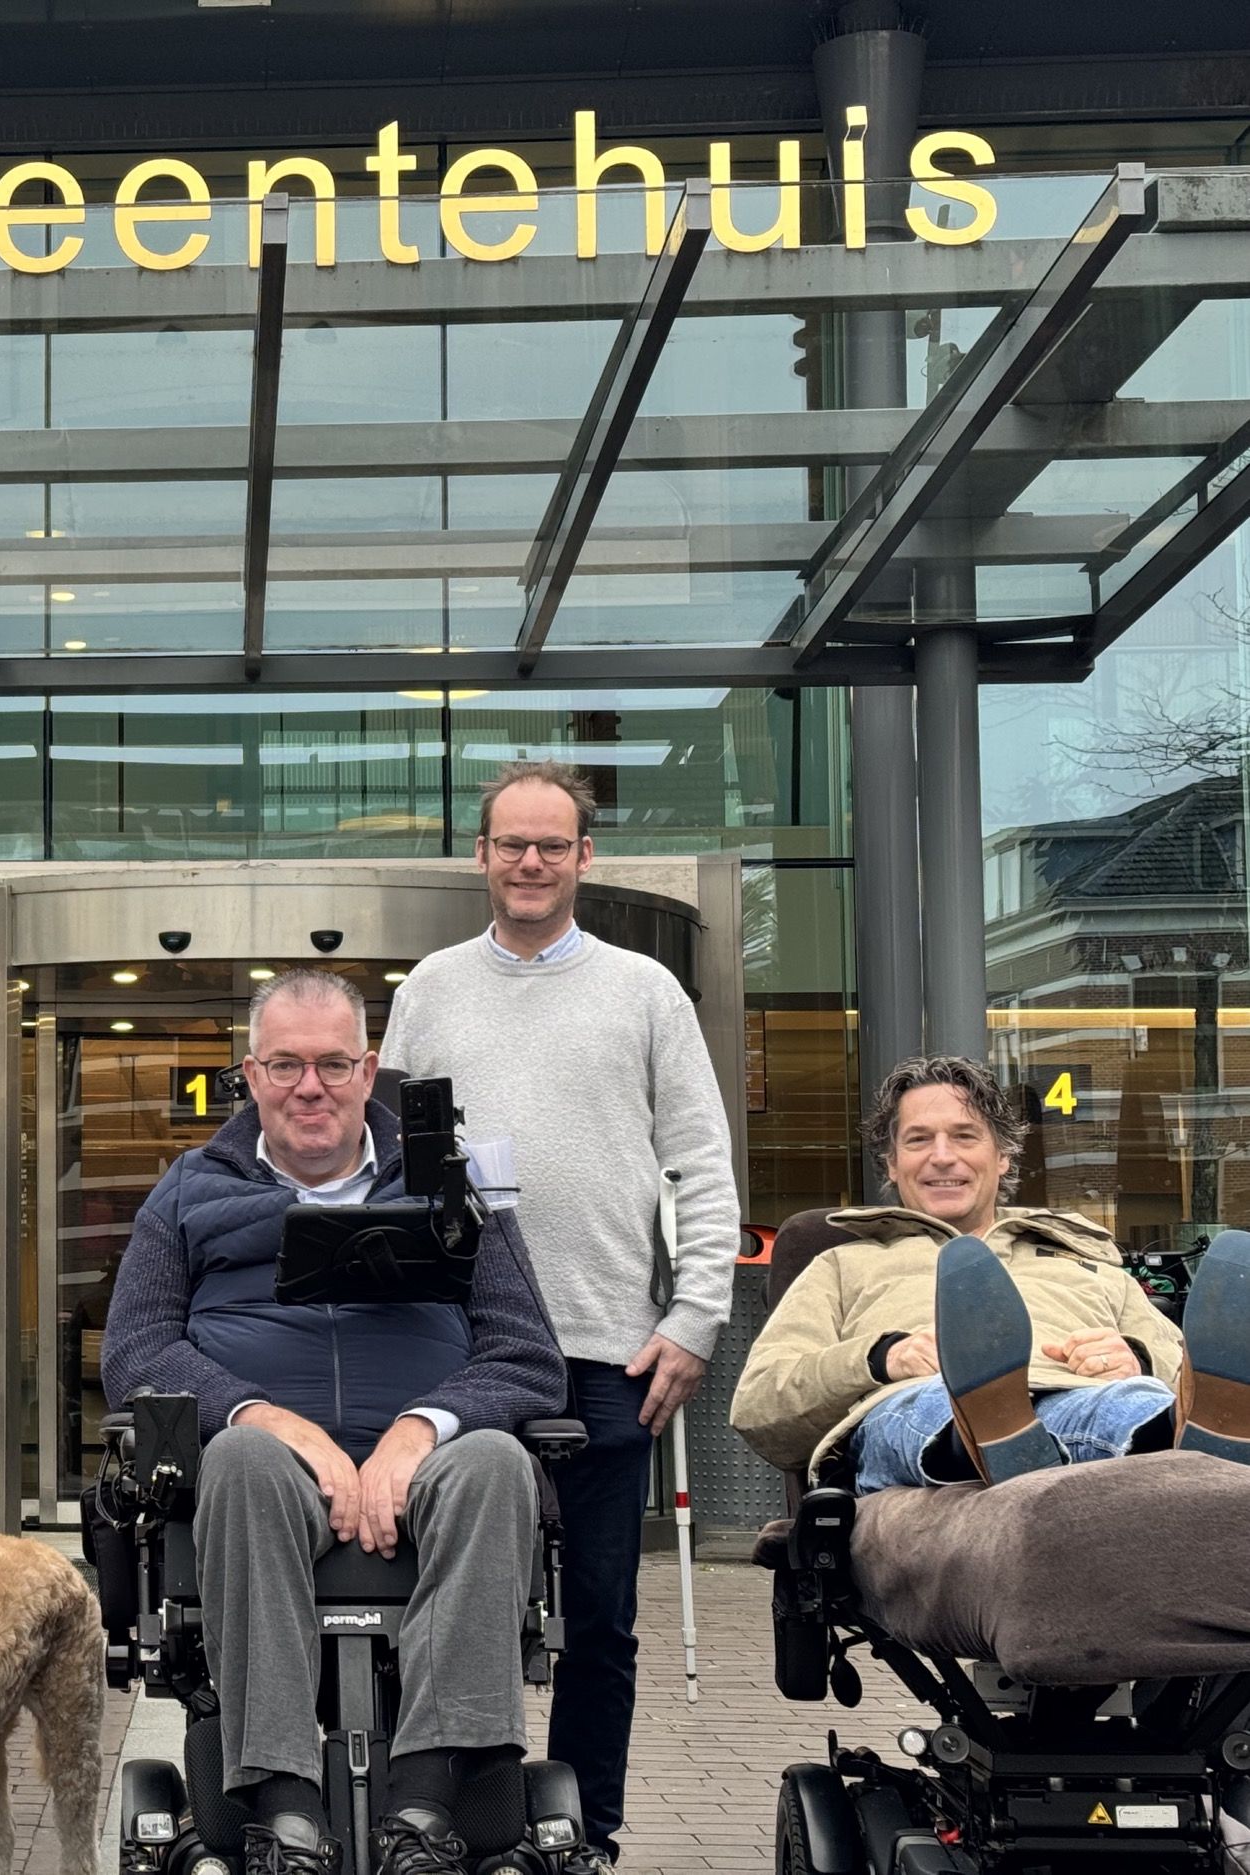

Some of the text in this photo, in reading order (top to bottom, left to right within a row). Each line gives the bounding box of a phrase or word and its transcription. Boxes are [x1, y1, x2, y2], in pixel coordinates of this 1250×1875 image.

[186, 1074, 206, 1116] 1
[1044, 1072, 1077, 1115] 4
[323, 1612, 381, 1627] permobil
